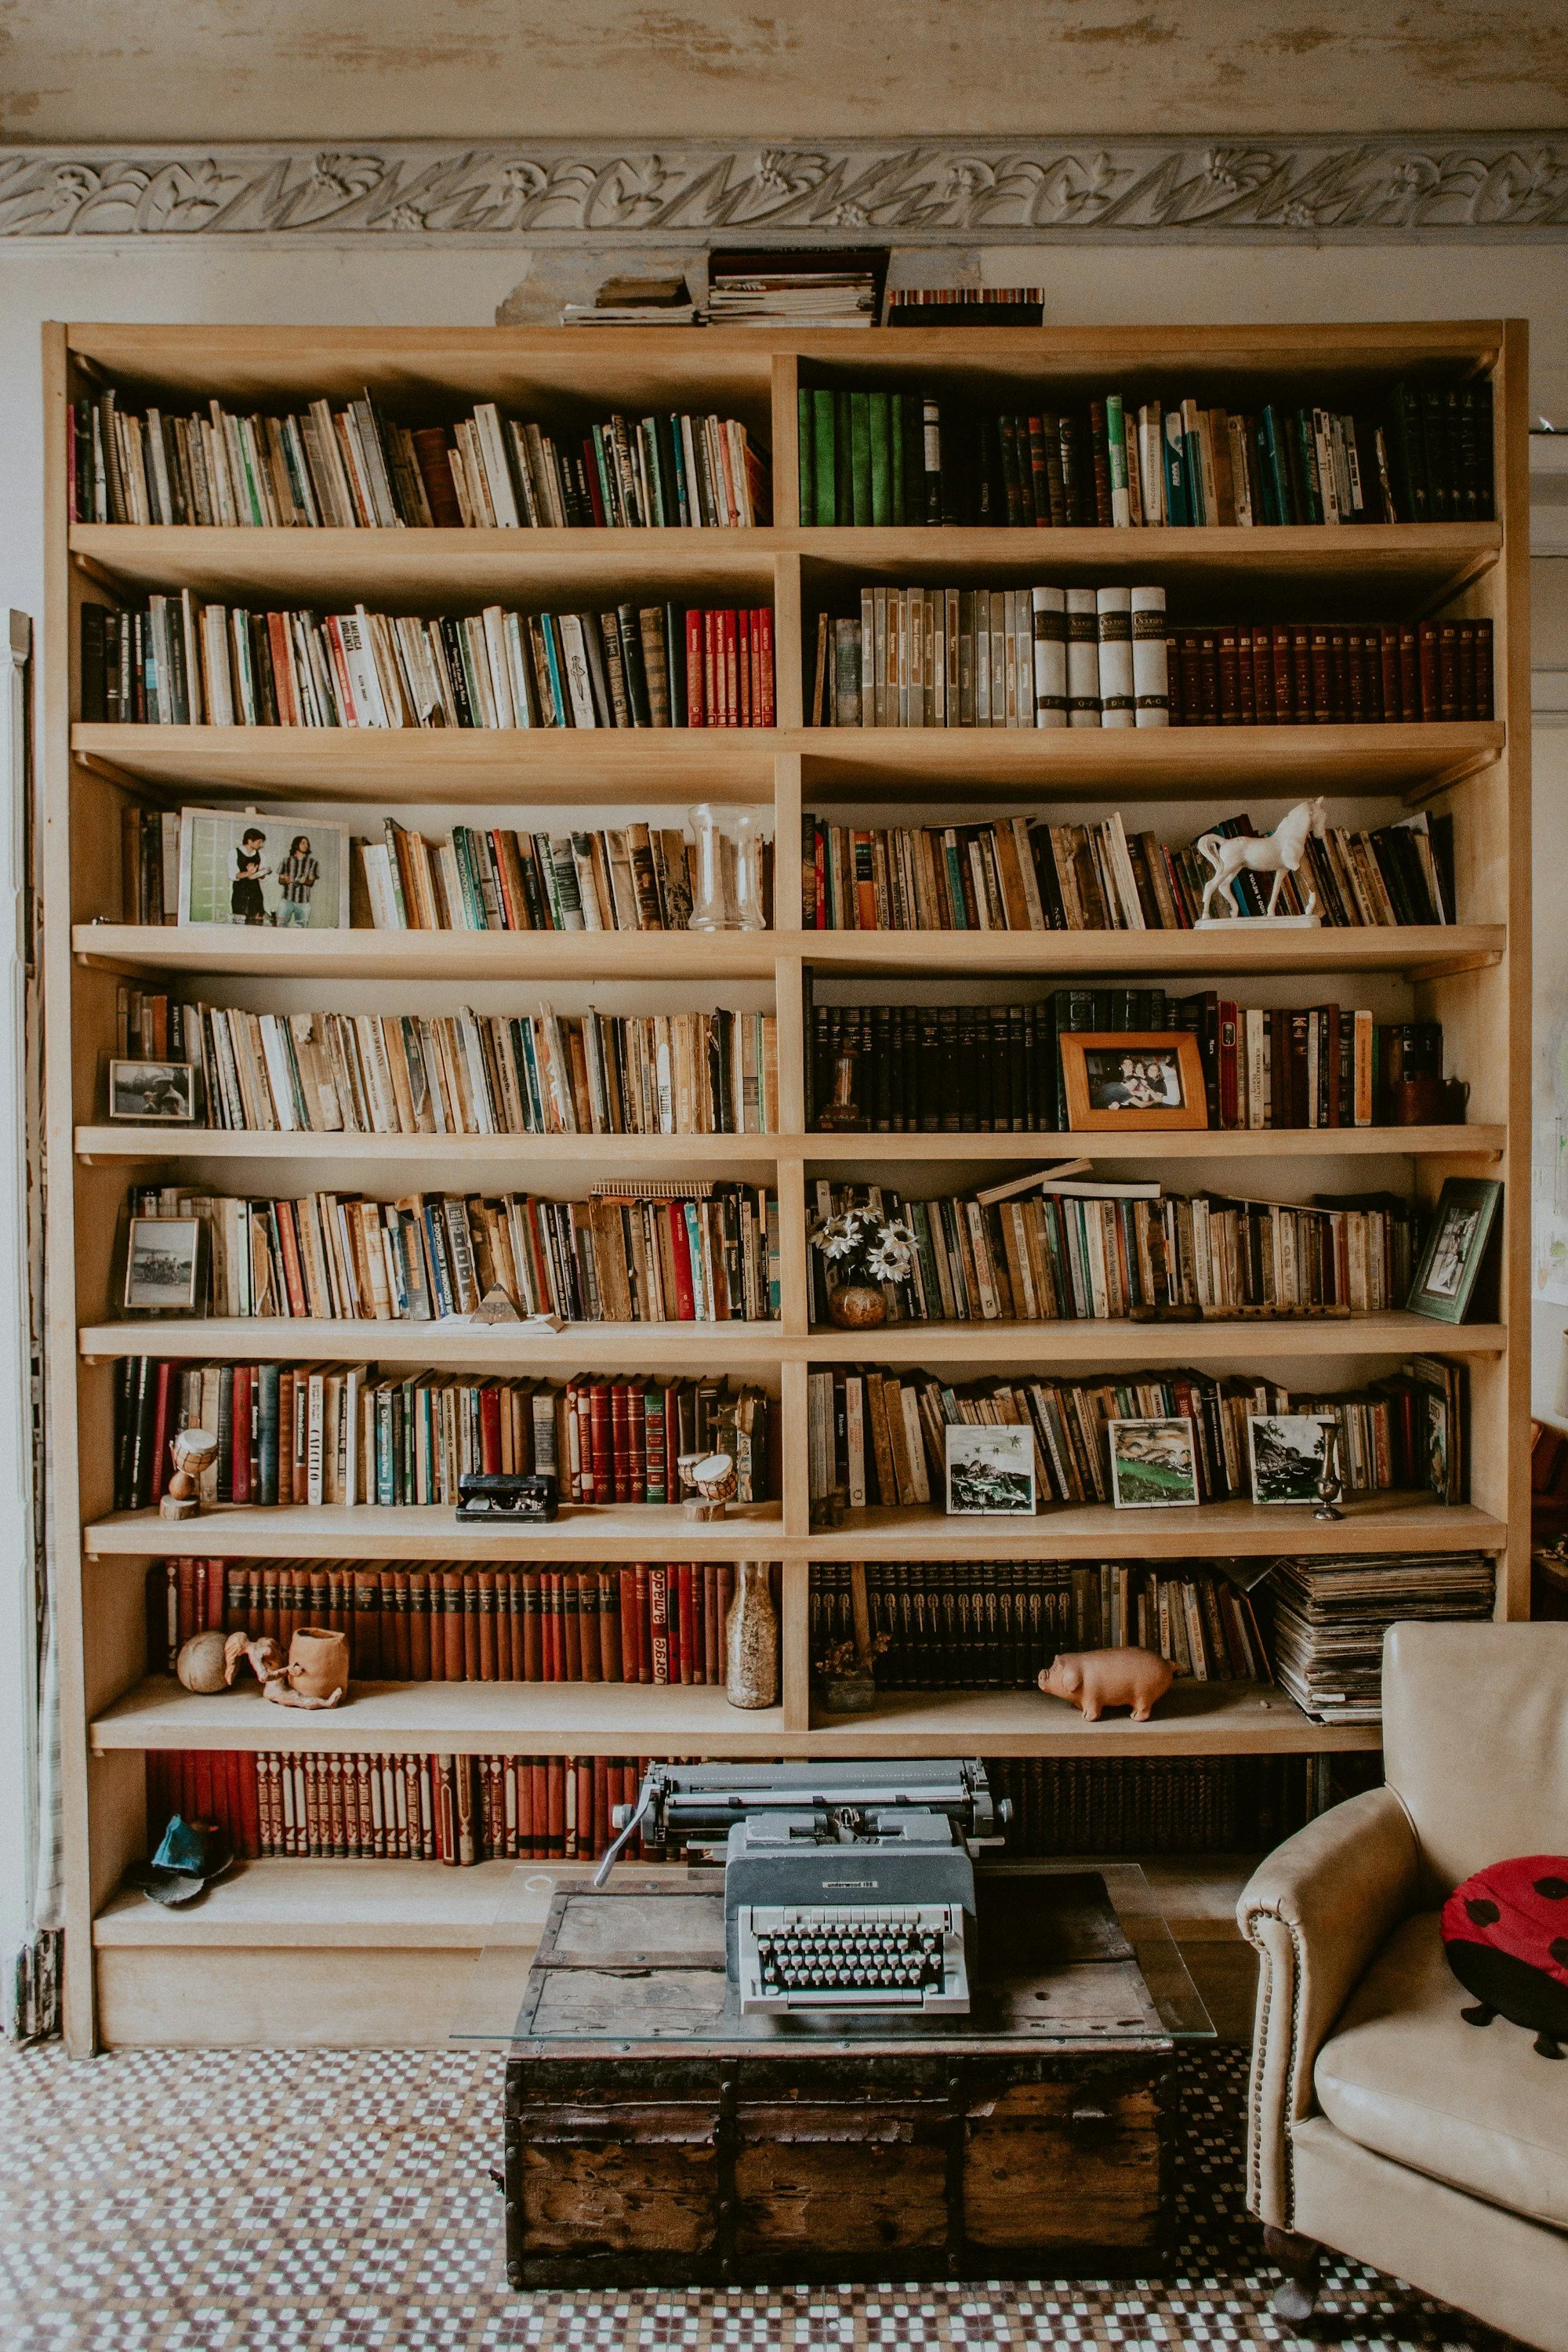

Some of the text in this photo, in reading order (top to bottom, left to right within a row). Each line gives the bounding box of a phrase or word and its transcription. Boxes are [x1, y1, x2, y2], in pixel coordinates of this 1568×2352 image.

[340, 621, 354, 652] VIOLENTA
[804, 818, 813, 837] DAN
[457, 848, 466, 872] HOMEM
[459, 873, 470, 891] NOVO
[1257, 901, 1267, 916] NDO
[496, 1041, 506, 1062] quinto
[499, 1063, 510, 1094] evangelho
[433, 1222, 445, 1259] MERCADOS
[550, 1237, 560, 1262] formação
[1107, 1236, 1116, 1259] Grande
[1108, 1259, 1117, 1279] Amigo
[440, 1269, 452, 1304] ECONOMIA
[579, 1414, 590, 1472] CURIOSIDADES
[1160, 1617, 1168, 1649] Milagre
